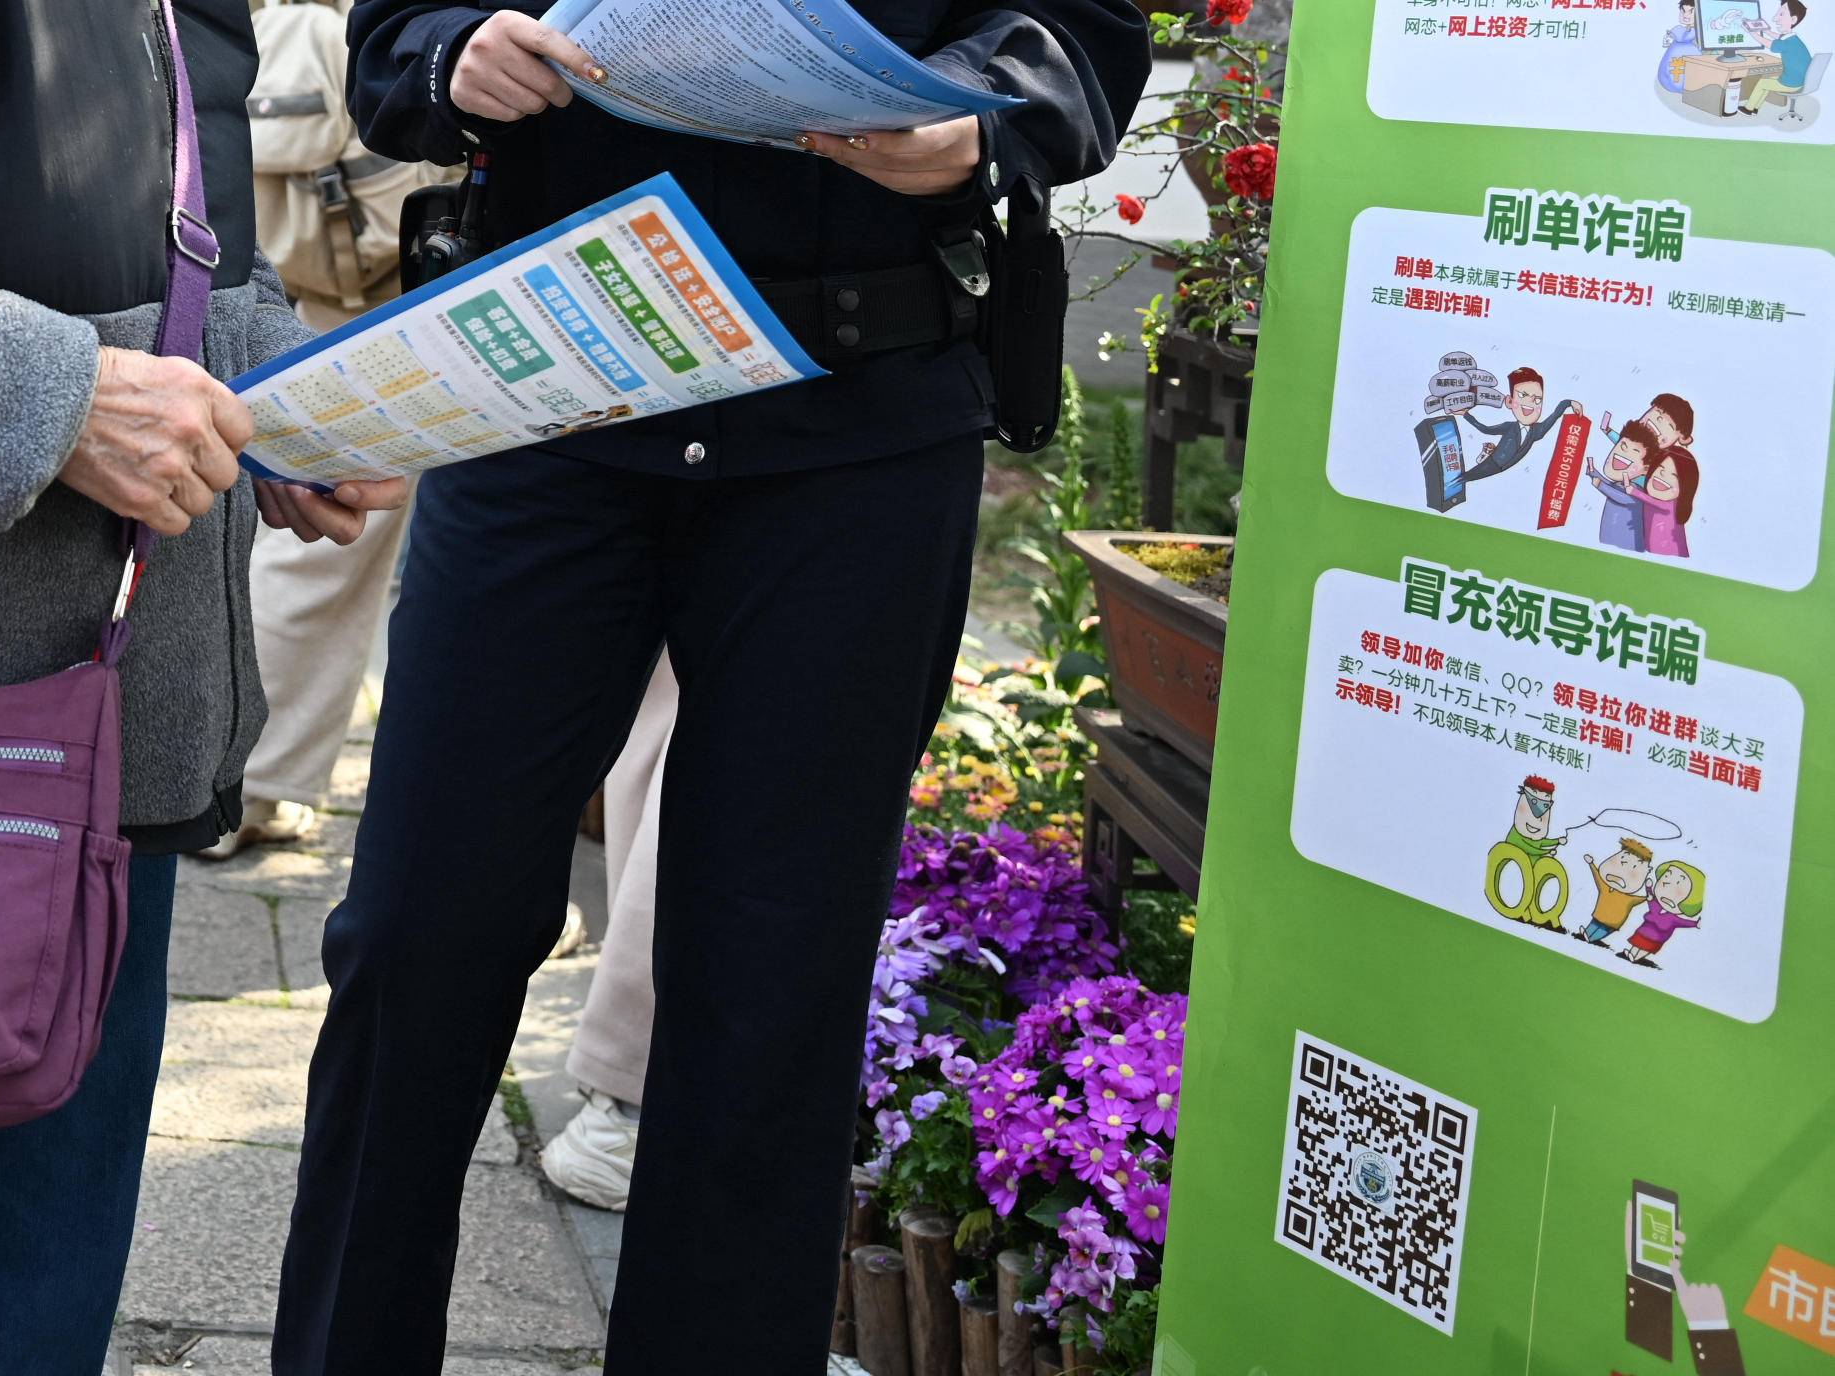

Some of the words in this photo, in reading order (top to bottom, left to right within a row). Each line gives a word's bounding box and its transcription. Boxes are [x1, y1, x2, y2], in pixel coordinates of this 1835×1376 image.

[1404, 15, 1587, 40] 网恋+网上投资才可怕！
[430, 43, 443, 103] POLICE
[1483, 194, 1685, 262] 刷单诈骗
[1371, 286, 1491, 318] 定是遇到诈骗！
[1403, 563, 1701, 685] 冒充领导诈骗
